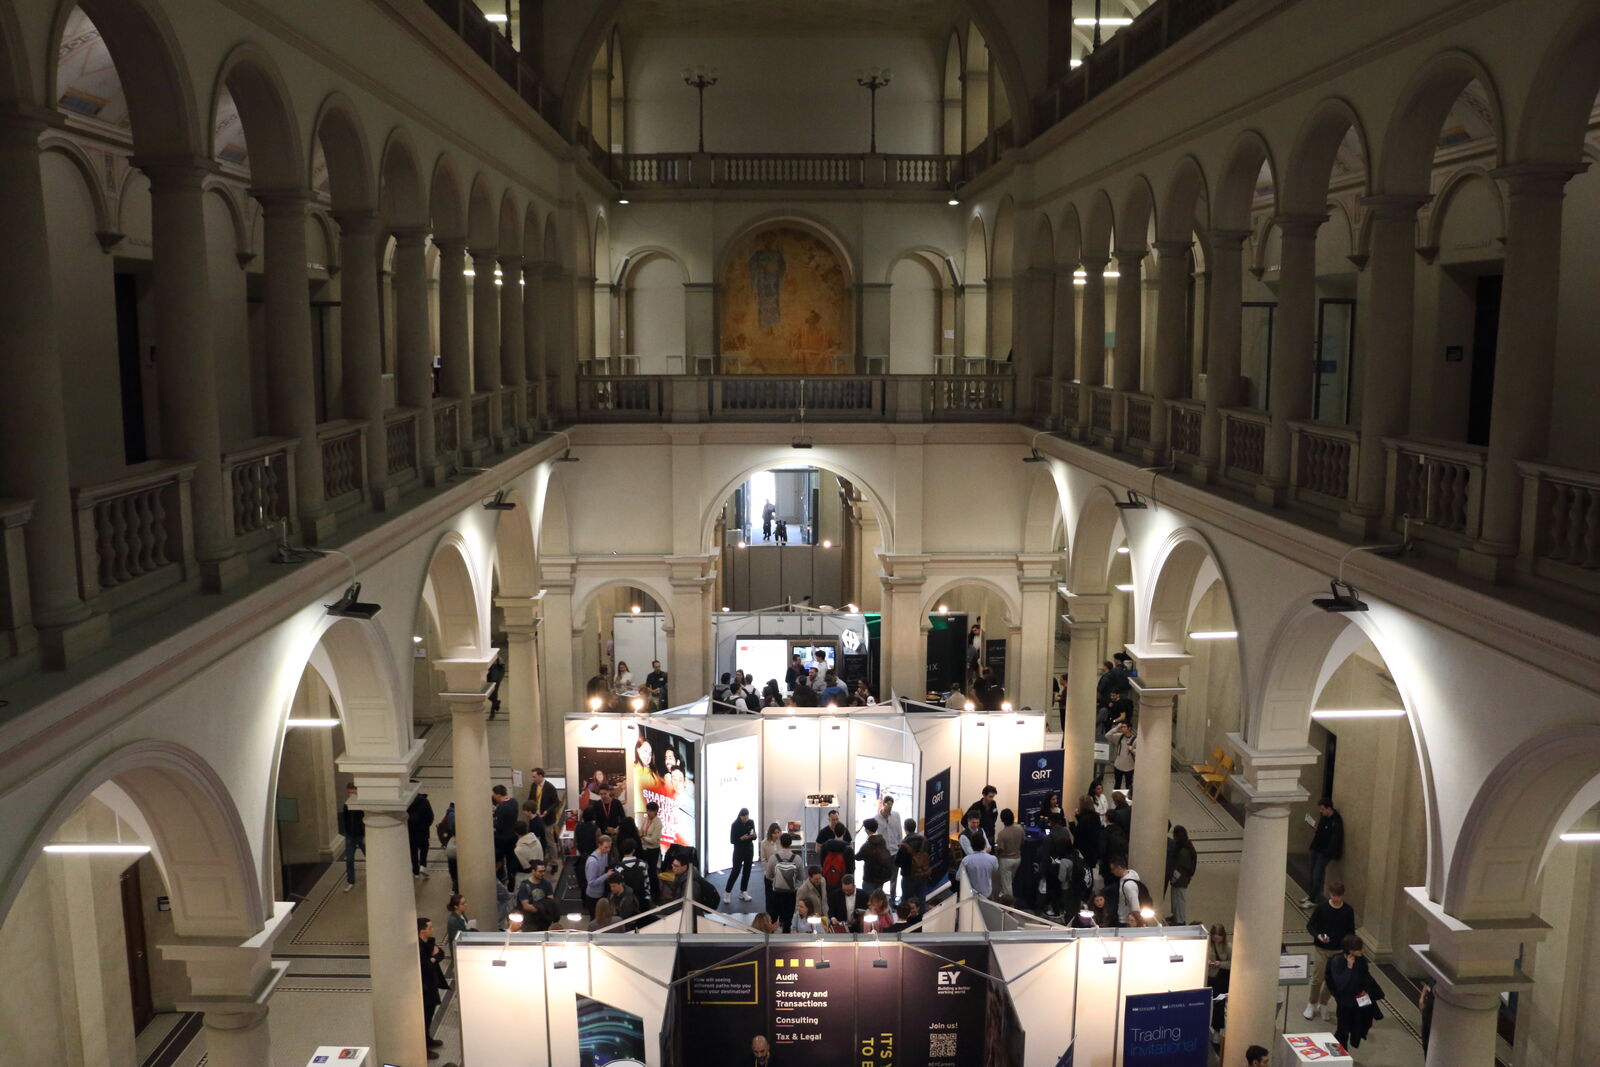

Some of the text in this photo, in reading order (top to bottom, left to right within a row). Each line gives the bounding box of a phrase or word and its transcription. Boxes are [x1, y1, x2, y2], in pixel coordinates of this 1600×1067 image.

[1031, 769, 1052, 780] QRT
[931, 790, 945, 805] QRT
[775, 973, 798, 981] Audit
[937, 971, 960, 985] EY
[775, 990, 828, 999] Strategy and
[775, 1016, 819, 1025] Consulting
[800, 1033, 822, 1042] Legal
[1130, 1026, 1181, 1041] Trading
[861, 1037, 874, 1056] TO
[880, 1033, 893, 1059] IT'S
